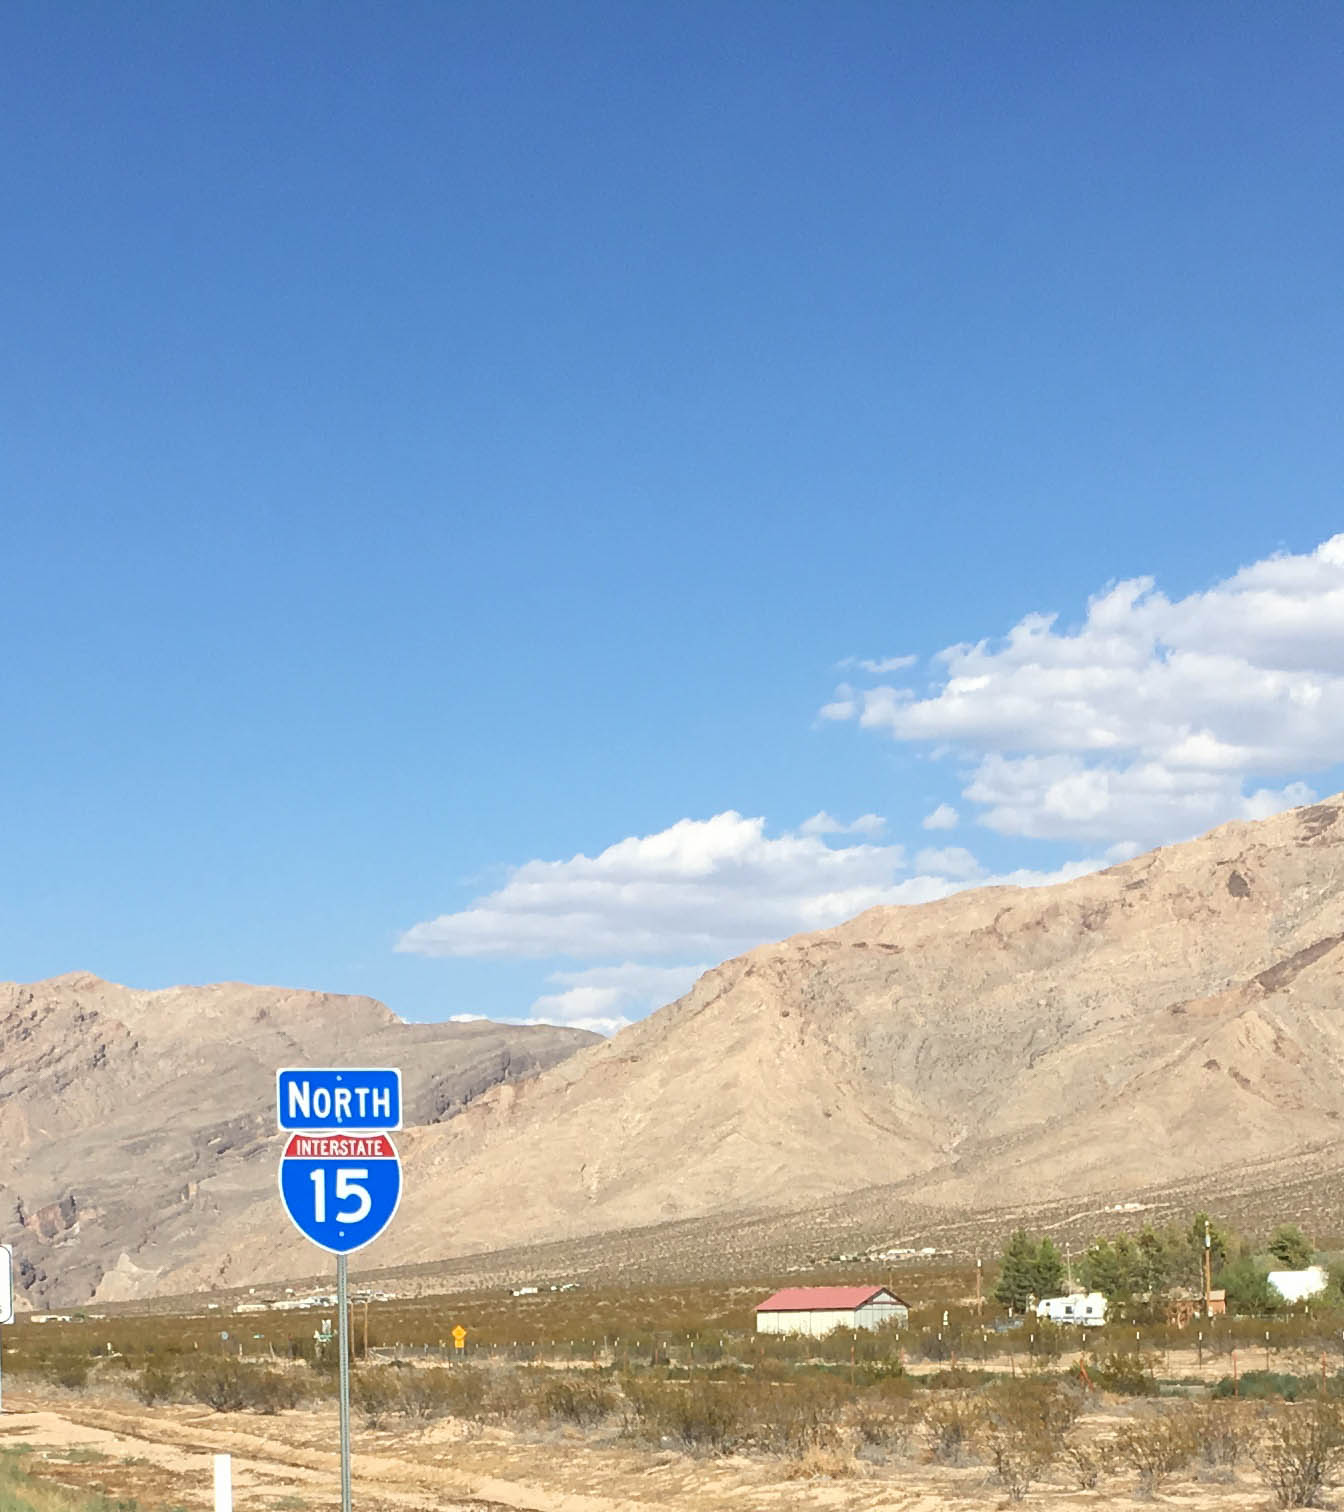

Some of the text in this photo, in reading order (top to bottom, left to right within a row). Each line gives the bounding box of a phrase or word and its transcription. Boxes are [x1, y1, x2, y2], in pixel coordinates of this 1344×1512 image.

[288, 1081, 391, 1118] NORTH
[296, 1139, 383, 1156] INTERSTATE
[310, 1168, 372, 1223] 15
